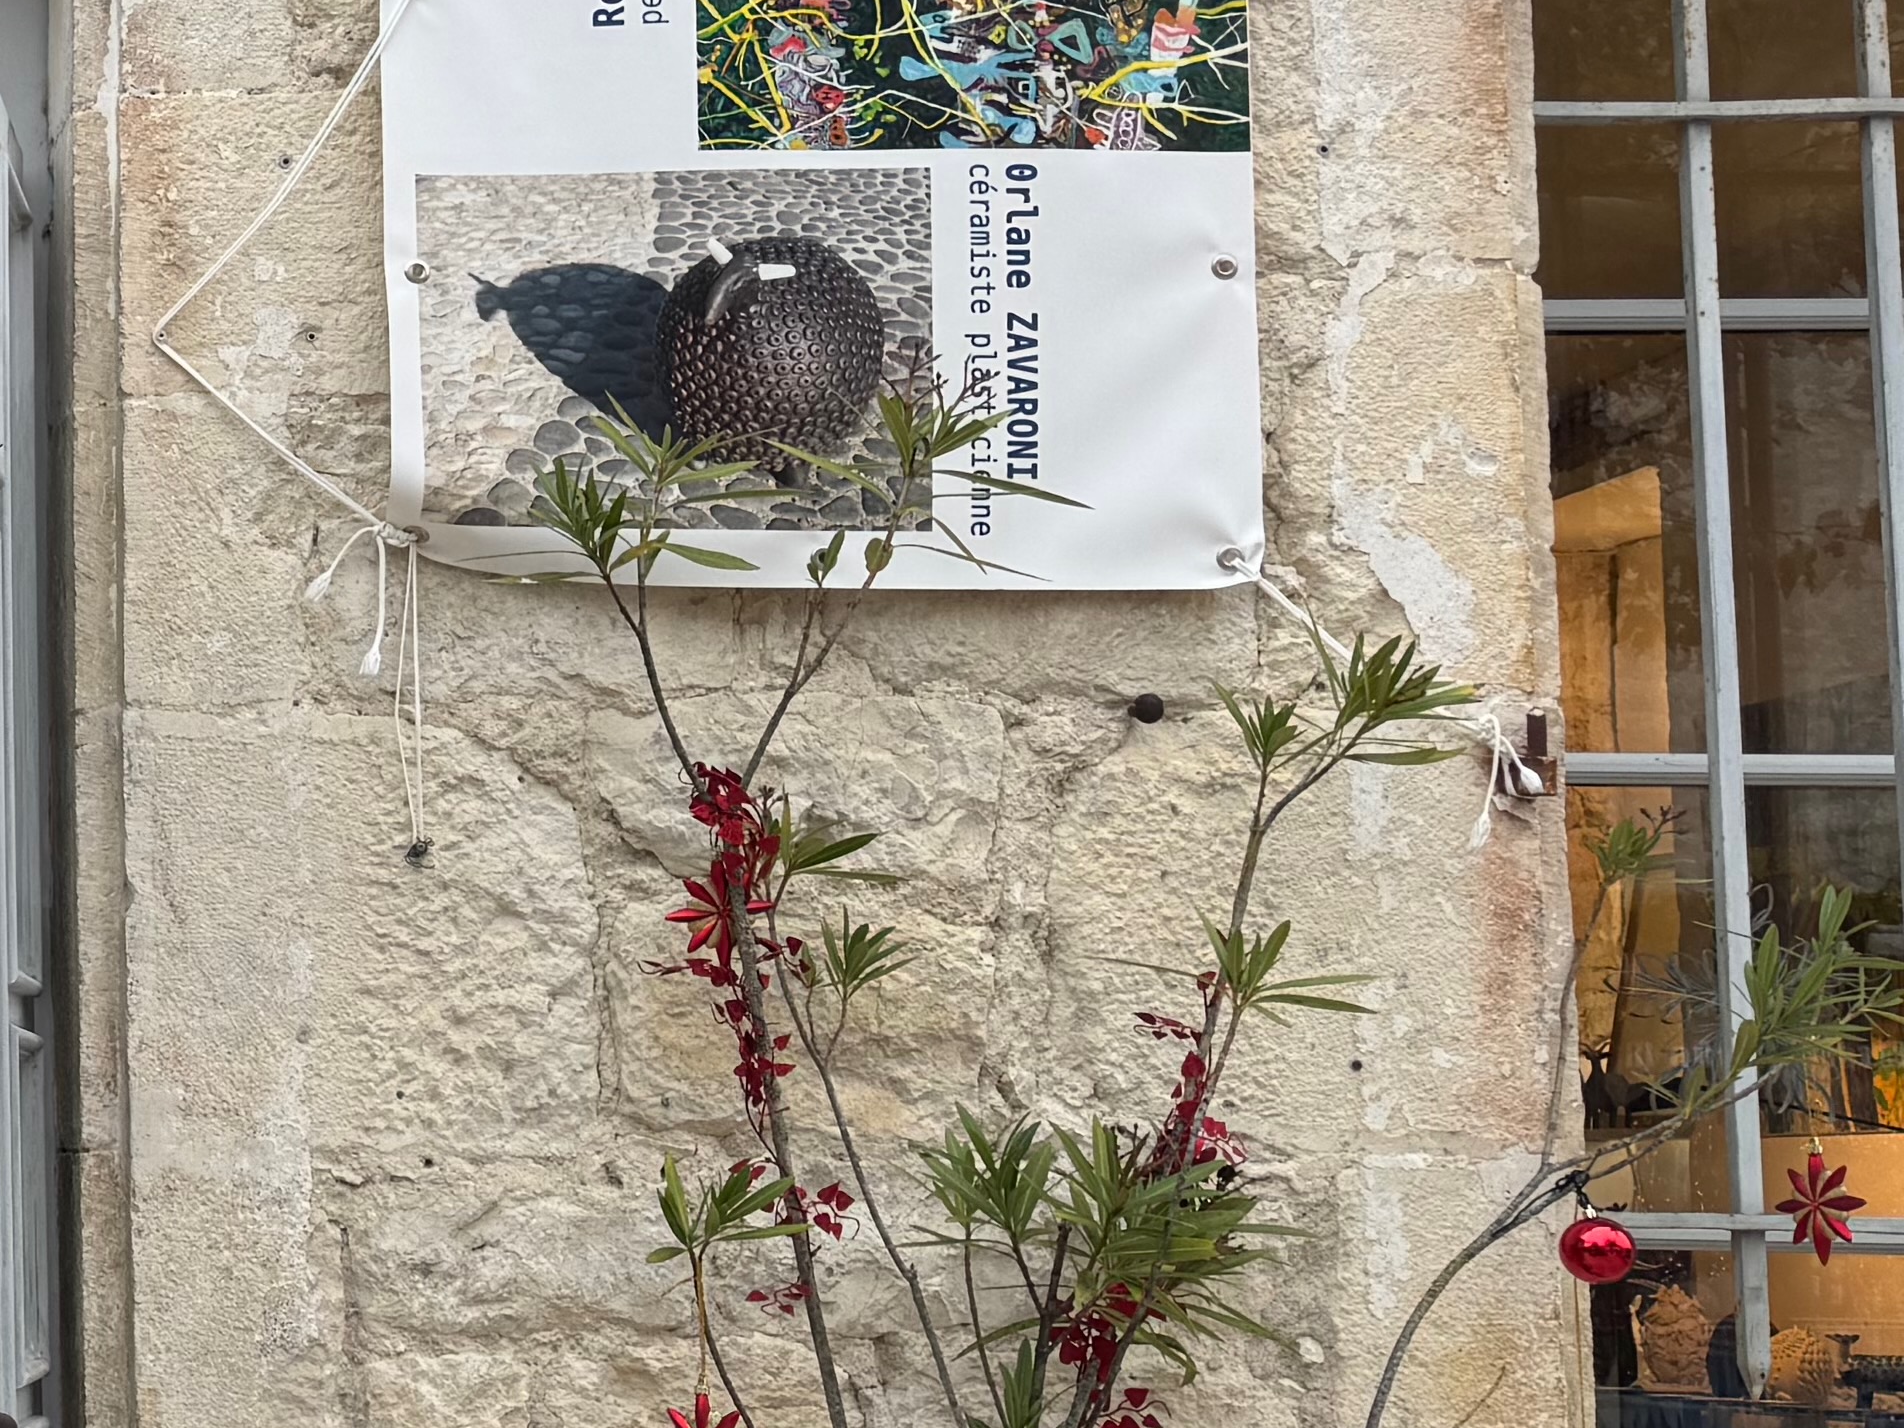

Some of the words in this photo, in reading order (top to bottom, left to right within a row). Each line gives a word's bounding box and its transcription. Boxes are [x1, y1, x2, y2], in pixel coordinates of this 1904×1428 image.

[969, 164, 997, 314] céramiste
[964, 333, 995, 536] plastcienne
[1003, 312, 1039, 486] ZAVARONI
